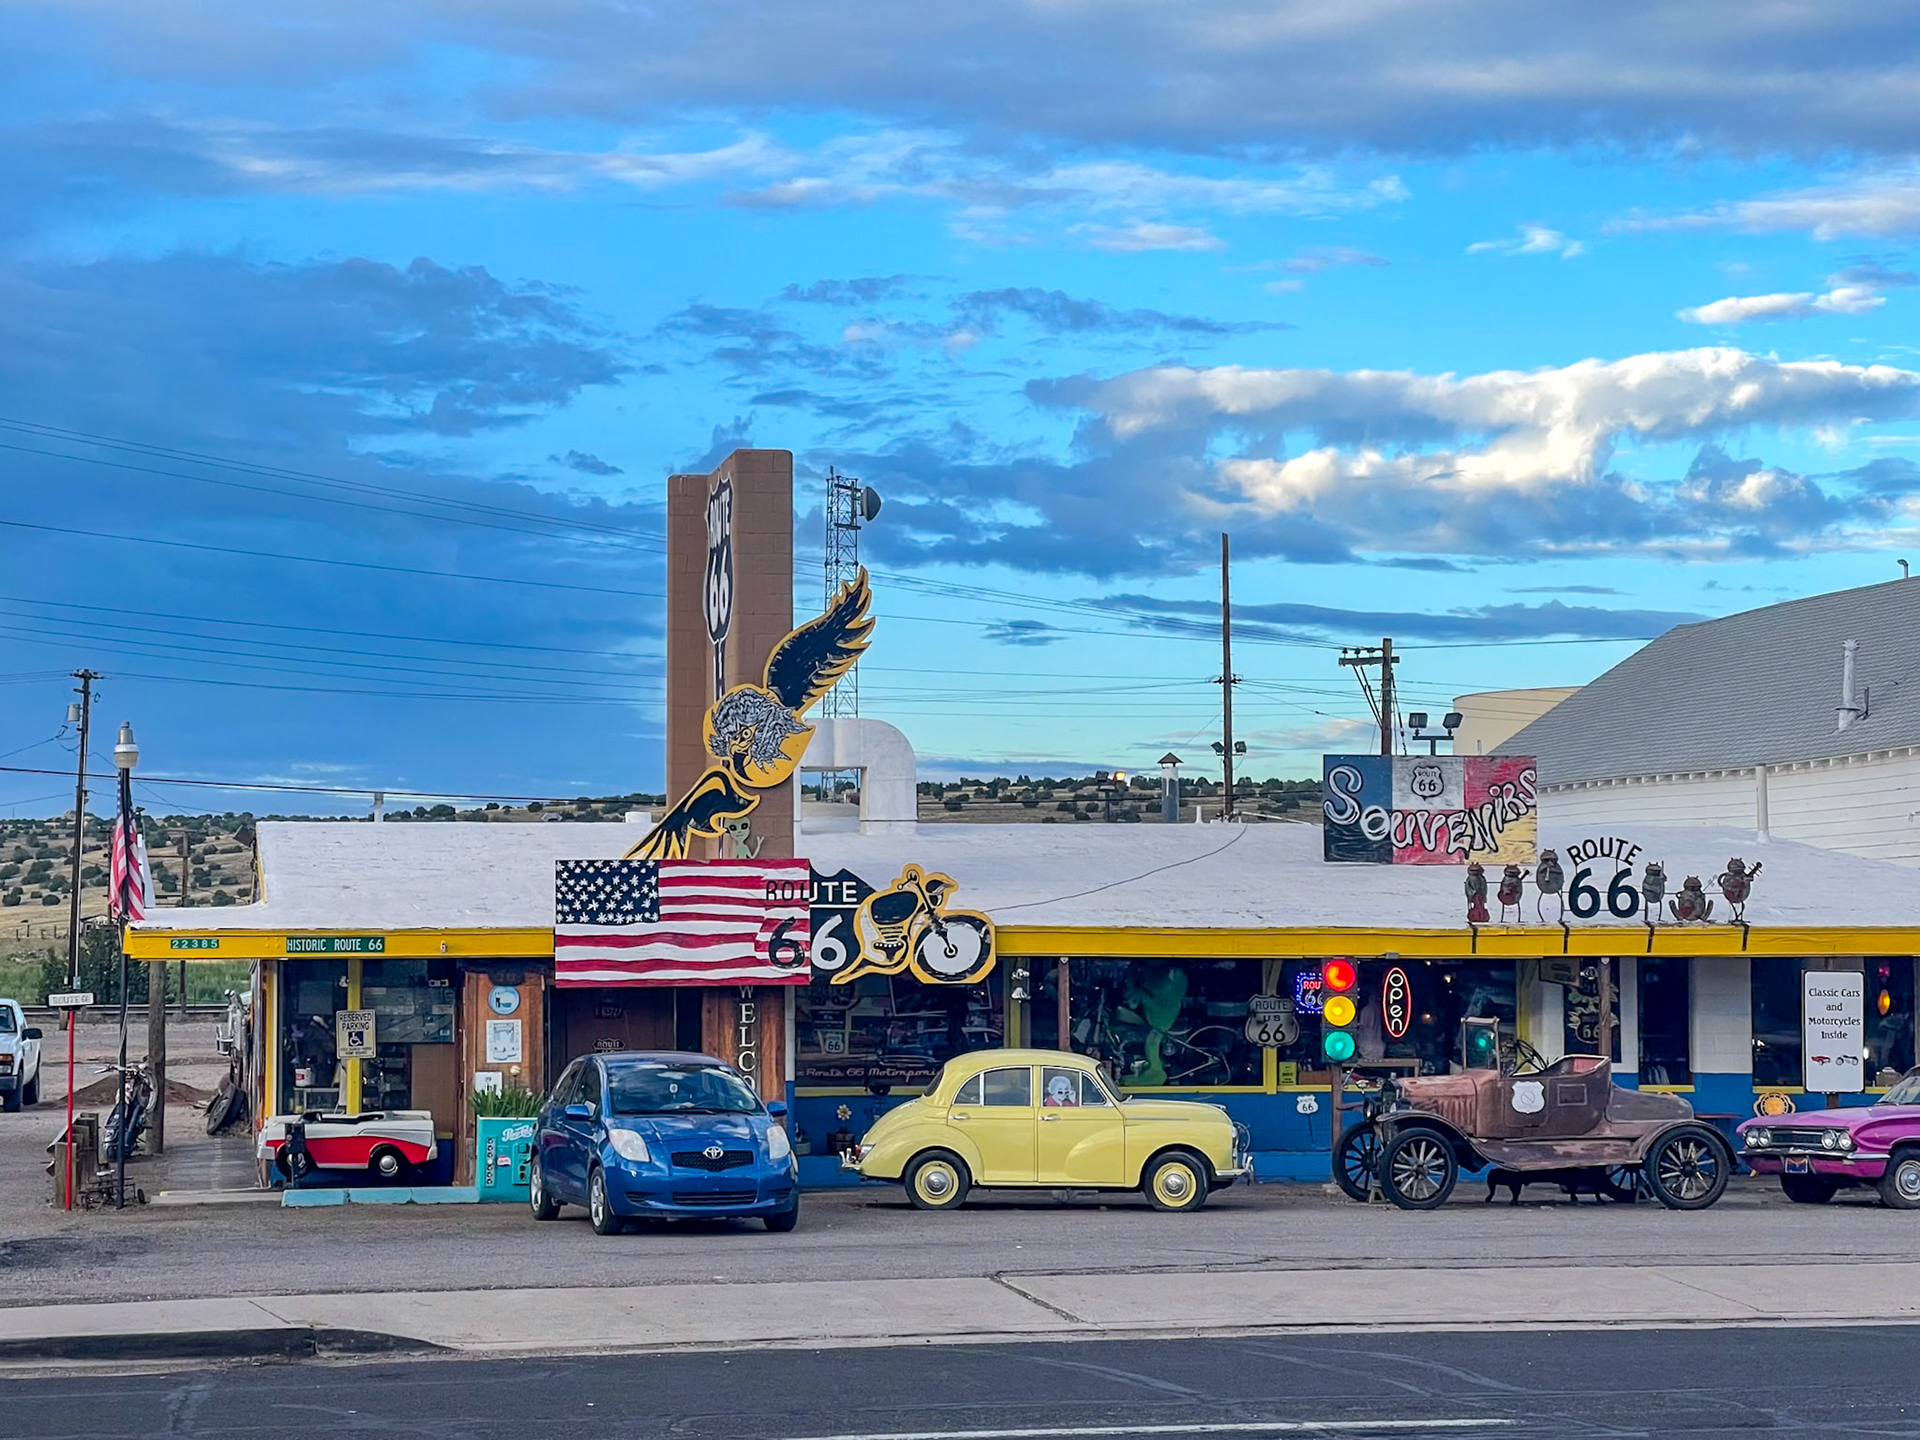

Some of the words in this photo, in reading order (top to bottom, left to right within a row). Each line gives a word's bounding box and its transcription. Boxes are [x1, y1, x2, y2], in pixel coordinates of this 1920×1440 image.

[709, 545, 729, 633] 66
[1419, 779, 1437, 792] 66
[1566, 837, 1643, 866] ROUTE
[766, 881, 857, 902] ROUTE
[1569, 867, 1640, 919] 66
[171, 939, 218, 949] 22385
[287, 938, 326, 951] HISTORIC
[334, 938, 361, 951] ROUTE
[368, 939, 383, 951] 66
[769, 914, 847, 970] 66
[1809, 988, 1839, 998] Classic
[1841, 988, 1860, 998] Cars
[52, 996, 80, 1004] ROUTE
[1255, 1001, 1288, 1010] ROUTE
[1826, 1003, 1843, 1012] and
[340, 1013, 372, 1022] RESERVED
[1808, 1017, 1861, 1027] Motorcycles
[342, 1022, 370, 1031] PARKING
[1258, 1023, 1286, 1043] 66
[1821, 1031, 1848, 1040] Inside
[827, 1041, 840, 1051] 66
[1302, 1103, 1314, 1112] 66
